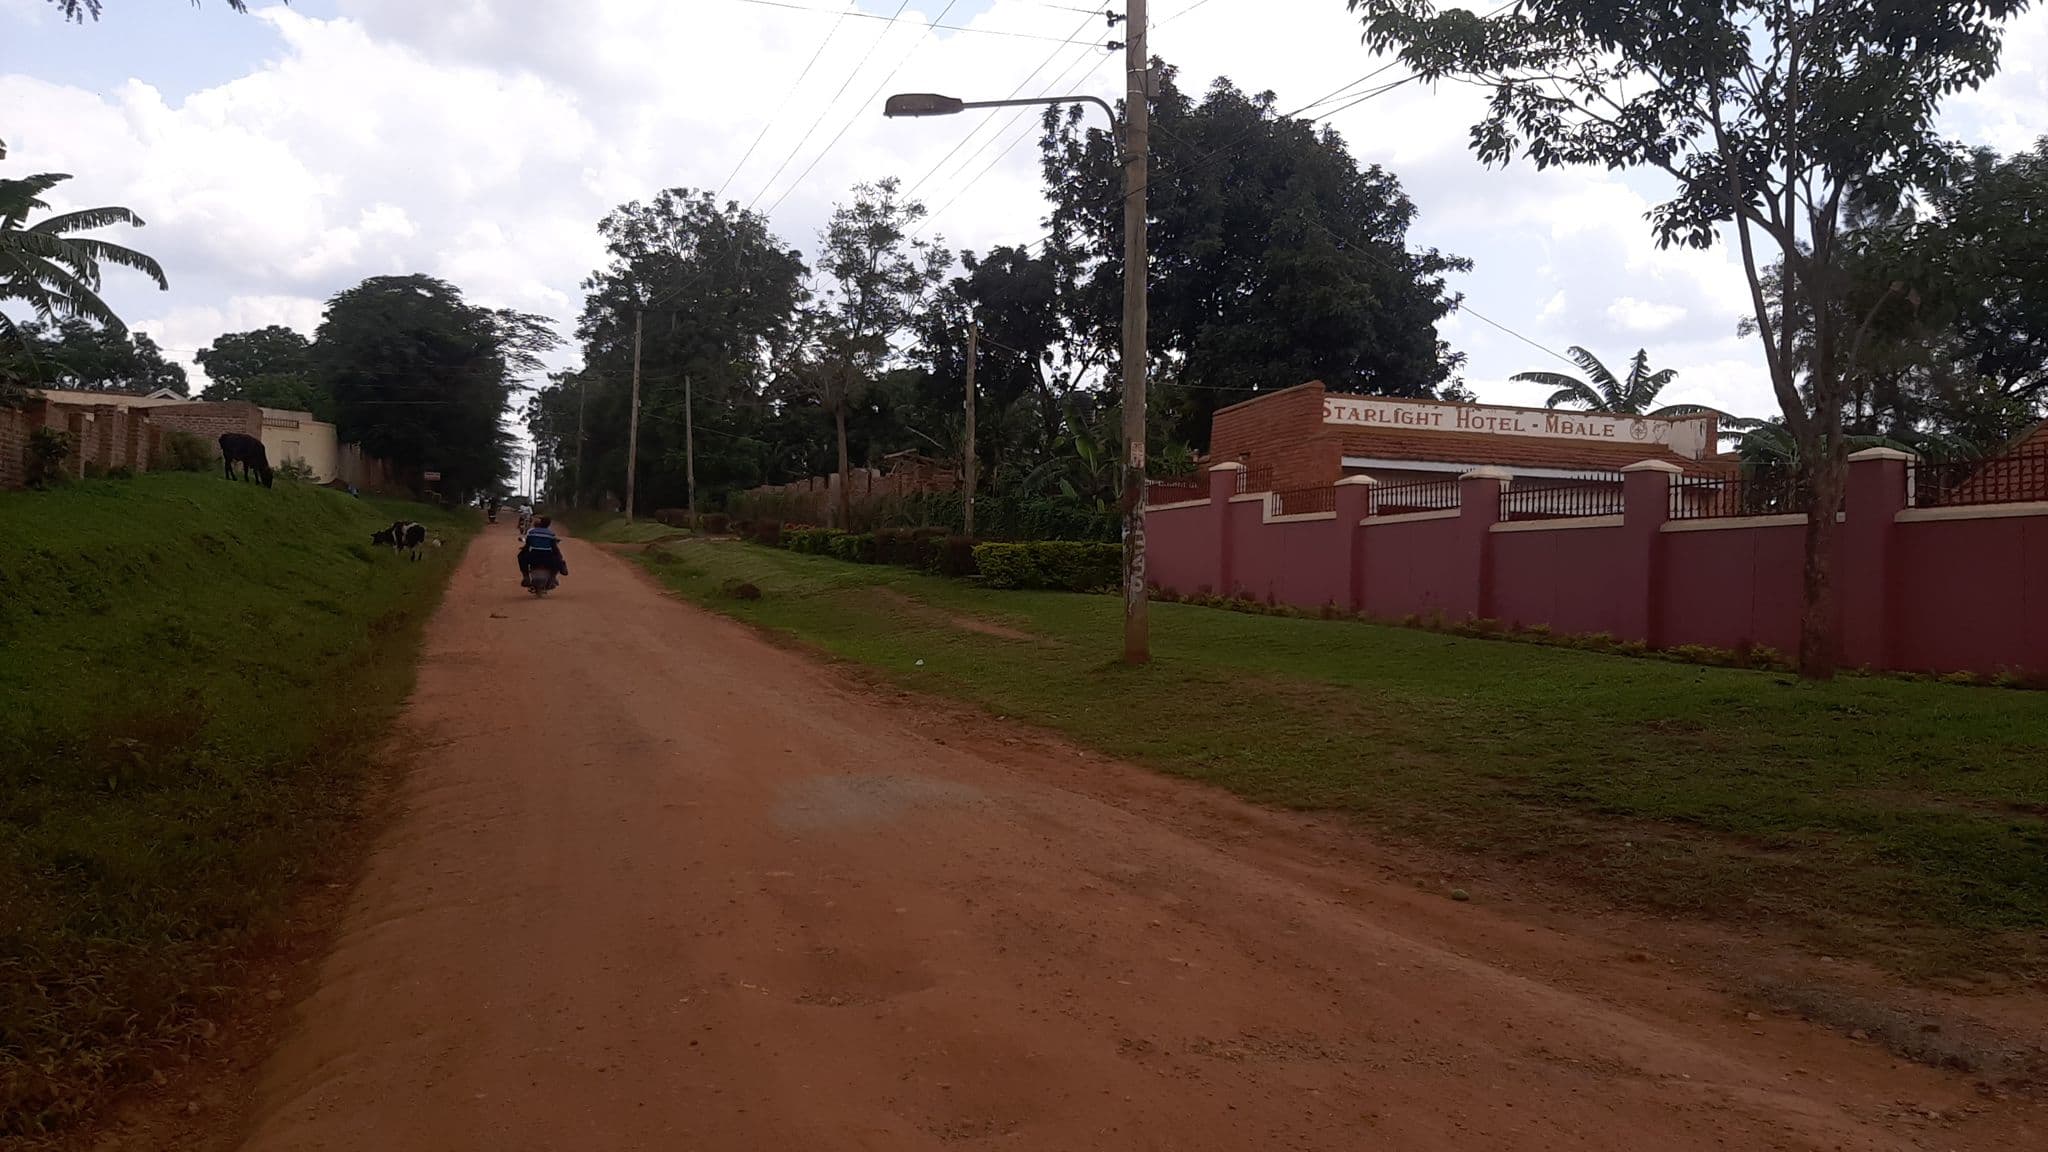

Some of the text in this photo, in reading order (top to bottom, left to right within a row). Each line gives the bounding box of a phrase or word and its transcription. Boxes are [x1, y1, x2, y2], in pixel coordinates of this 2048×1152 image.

[1323, 400, 1443, 427] STARLIGHT
[1456, 406, 1526, 432] HOTEL
[1545, 414, 1616, 437] MBALE
